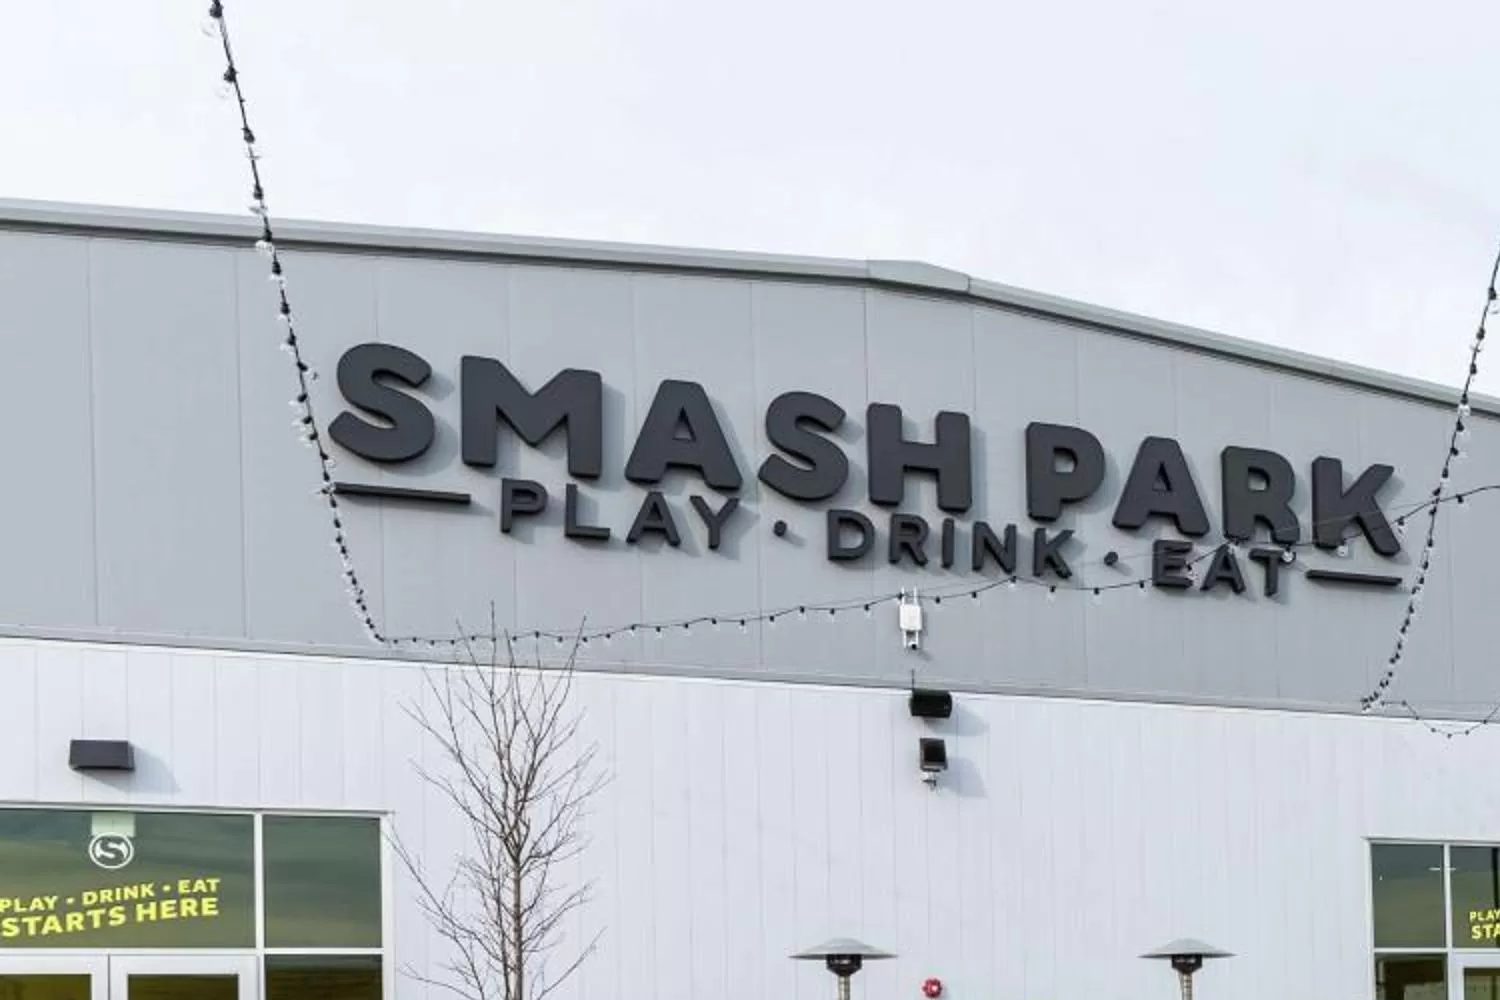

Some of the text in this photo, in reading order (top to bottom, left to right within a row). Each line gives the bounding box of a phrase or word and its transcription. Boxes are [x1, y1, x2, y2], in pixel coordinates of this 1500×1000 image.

[327, 342, 1402, 559] SMASH PARK
[500, 477, 1288, 597] PLAY DRINK EAT
[0, 878, 221, 913] PLAY DRINK EAT
[1, 897, 220, 937] STARTS HERE
